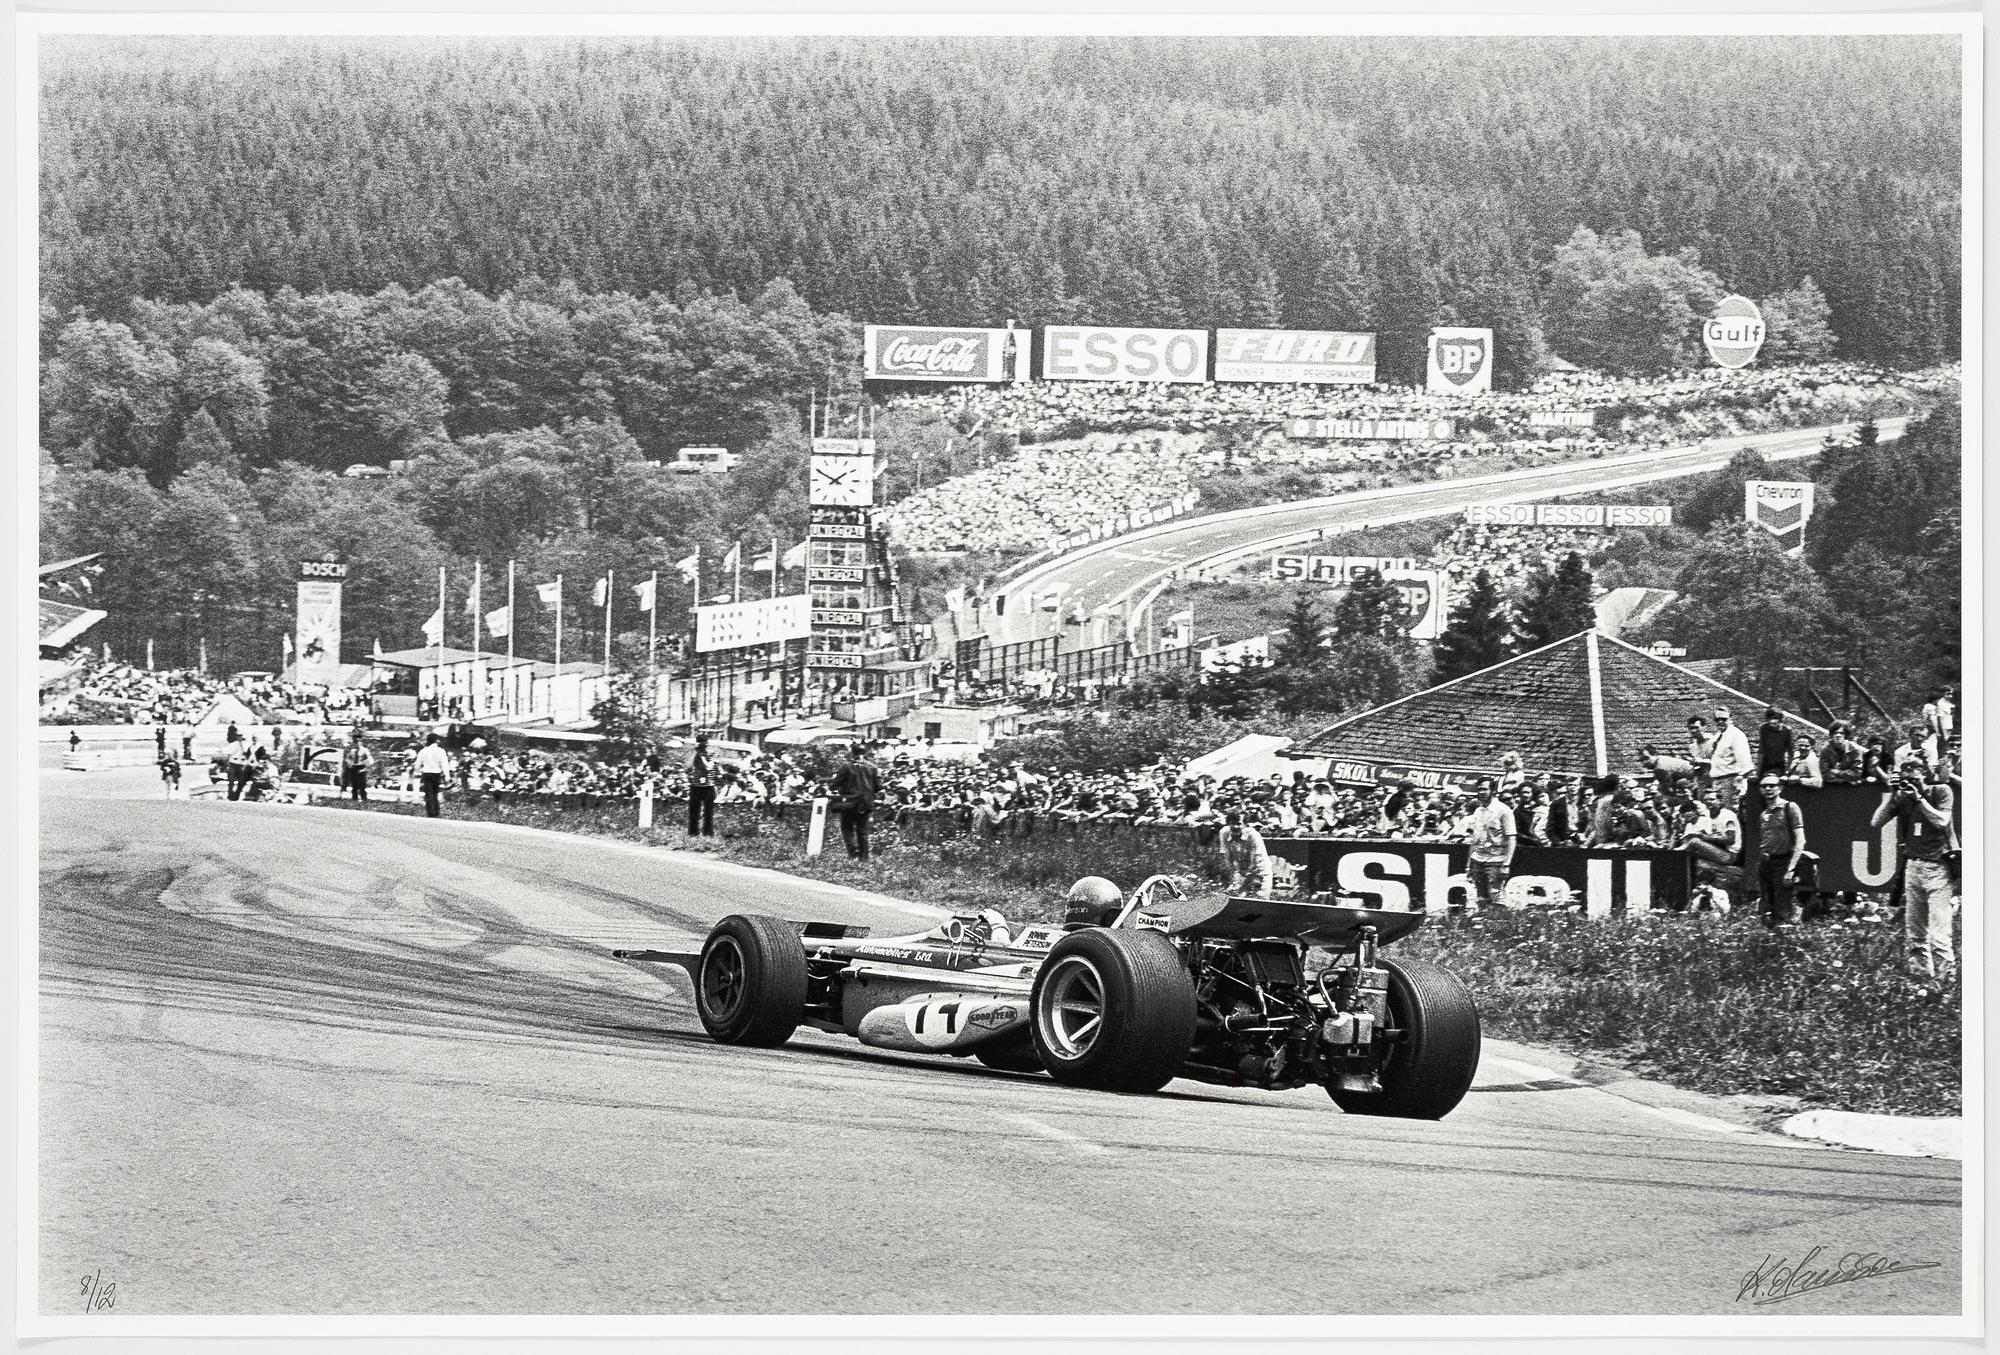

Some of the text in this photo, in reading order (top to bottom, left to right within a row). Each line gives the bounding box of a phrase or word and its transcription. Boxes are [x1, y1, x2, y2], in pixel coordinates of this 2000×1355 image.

[1708, 321, 1761, 342] Gulf
[882, 336, 981, 372] Coca-Cola
[1050, 331, 1199, 377] ESSO
[1227, 333, 1371, 363] FORD
[1442, 344, 1482, 373] BP
[1315, 420, 1430, 439] STELLA ARTOIS
[1756, 485, 1803, 499] Chevron
[1472, 506, 1528, 523] ESSO
[1544, 507, 1598, 523] ESSO
[1612, 508, 1666, 525] ESSO
[811, 525, 863, 537] UNIROYAL
[302, 561, 347, 577] BOSCH
[809, 569, 862, 581] UNIROYAL
[808, 655, 860, 667] UNIROYAL
[1332, 763, 1379, 783] SKOLL
[1336, 852, 1653, 914] Shell
[1138, 917, 1169, 928] CHAMPION
[855, 945, 933, 963] Automobiles Ltd.
[80, 1269, 117, 1314] 8/12
